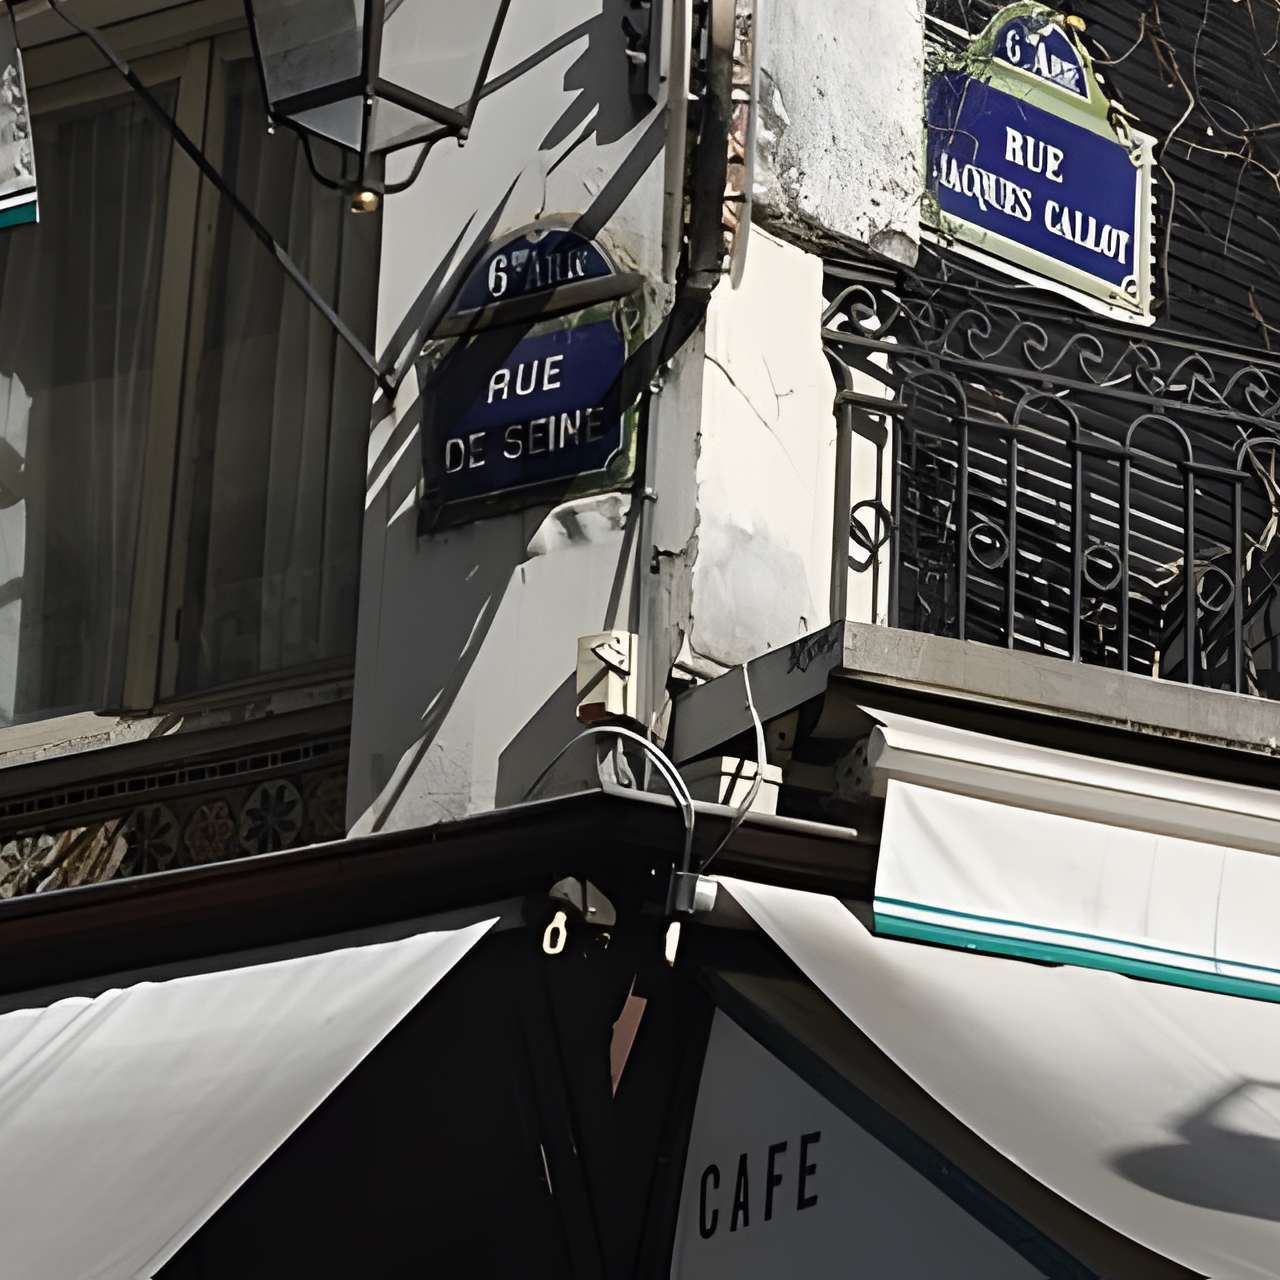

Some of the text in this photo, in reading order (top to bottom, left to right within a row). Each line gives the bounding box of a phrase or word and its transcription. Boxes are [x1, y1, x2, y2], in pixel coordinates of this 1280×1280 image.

[1004, 125, 1064, 183] RUE
[1045, 199, 1130, 265] CALLOT
[487, 354, 564, 404] RUE
[445, 406, 606, 474] DE SEINE
[699, 1130, 822, 1240] CAFE
